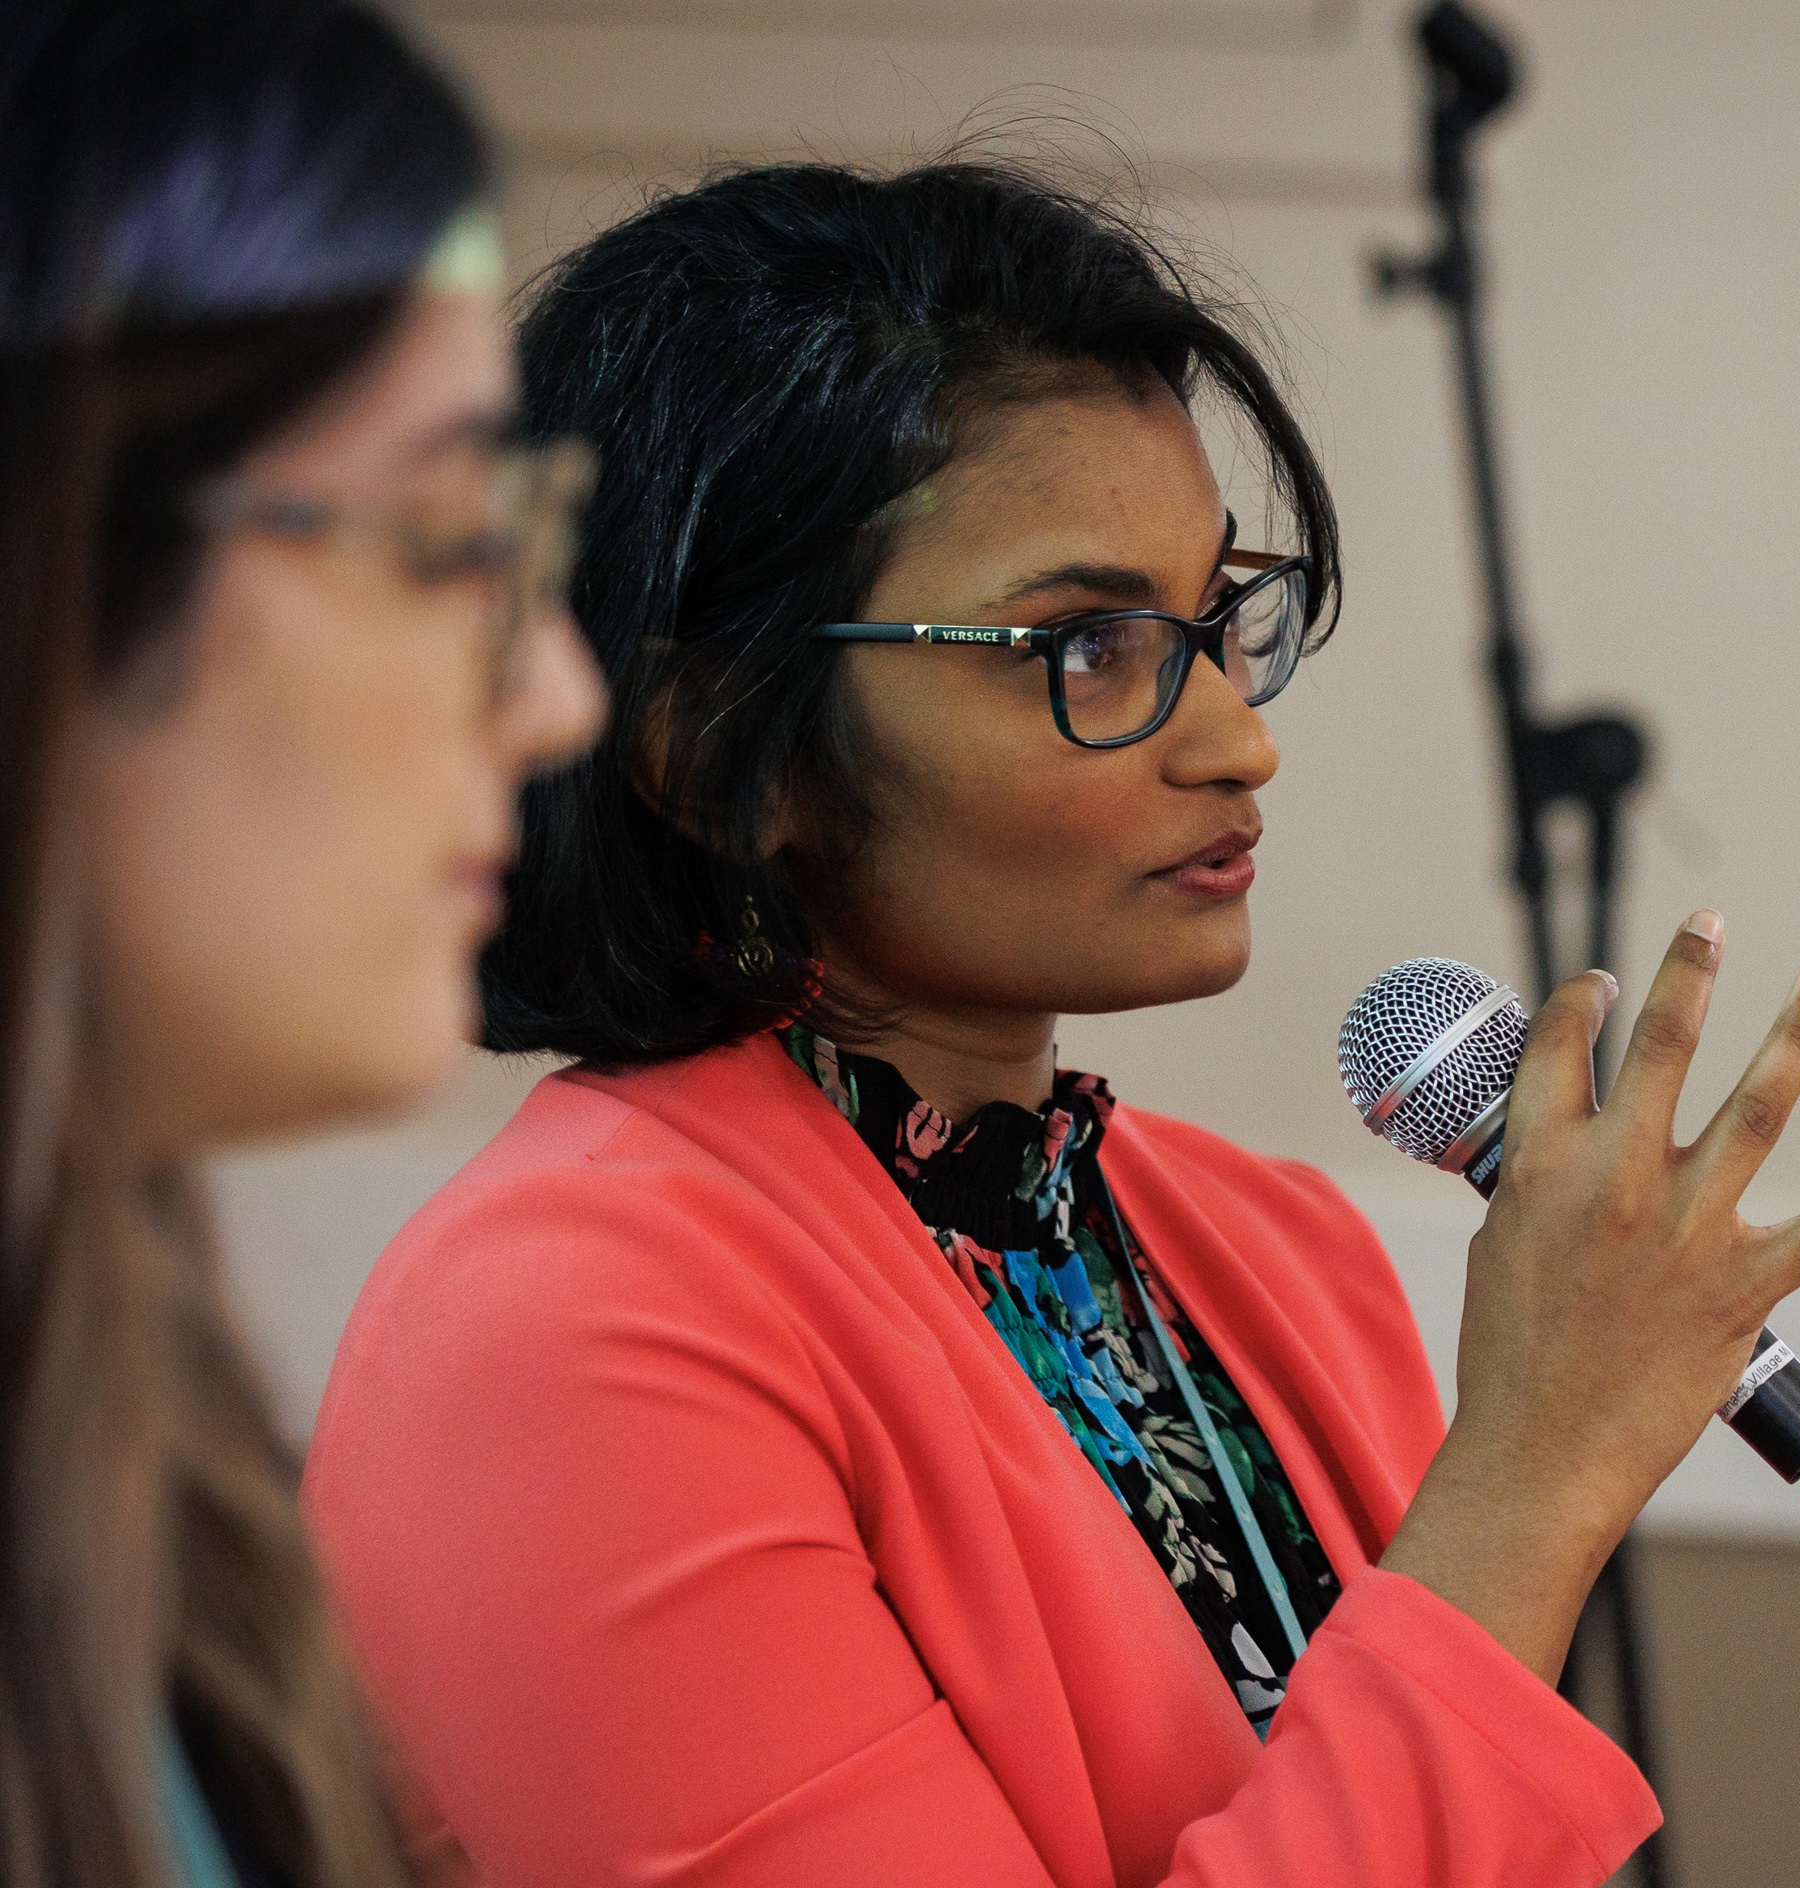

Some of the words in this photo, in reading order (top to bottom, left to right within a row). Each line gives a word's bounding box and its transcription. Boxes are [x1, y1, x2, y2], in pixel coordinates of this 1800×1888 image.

[942, 630, 999, 642] VERSACE
[1471, 1141, 1504, 1185] SHUR
[1746, 1353, 1783, 1386] Village
